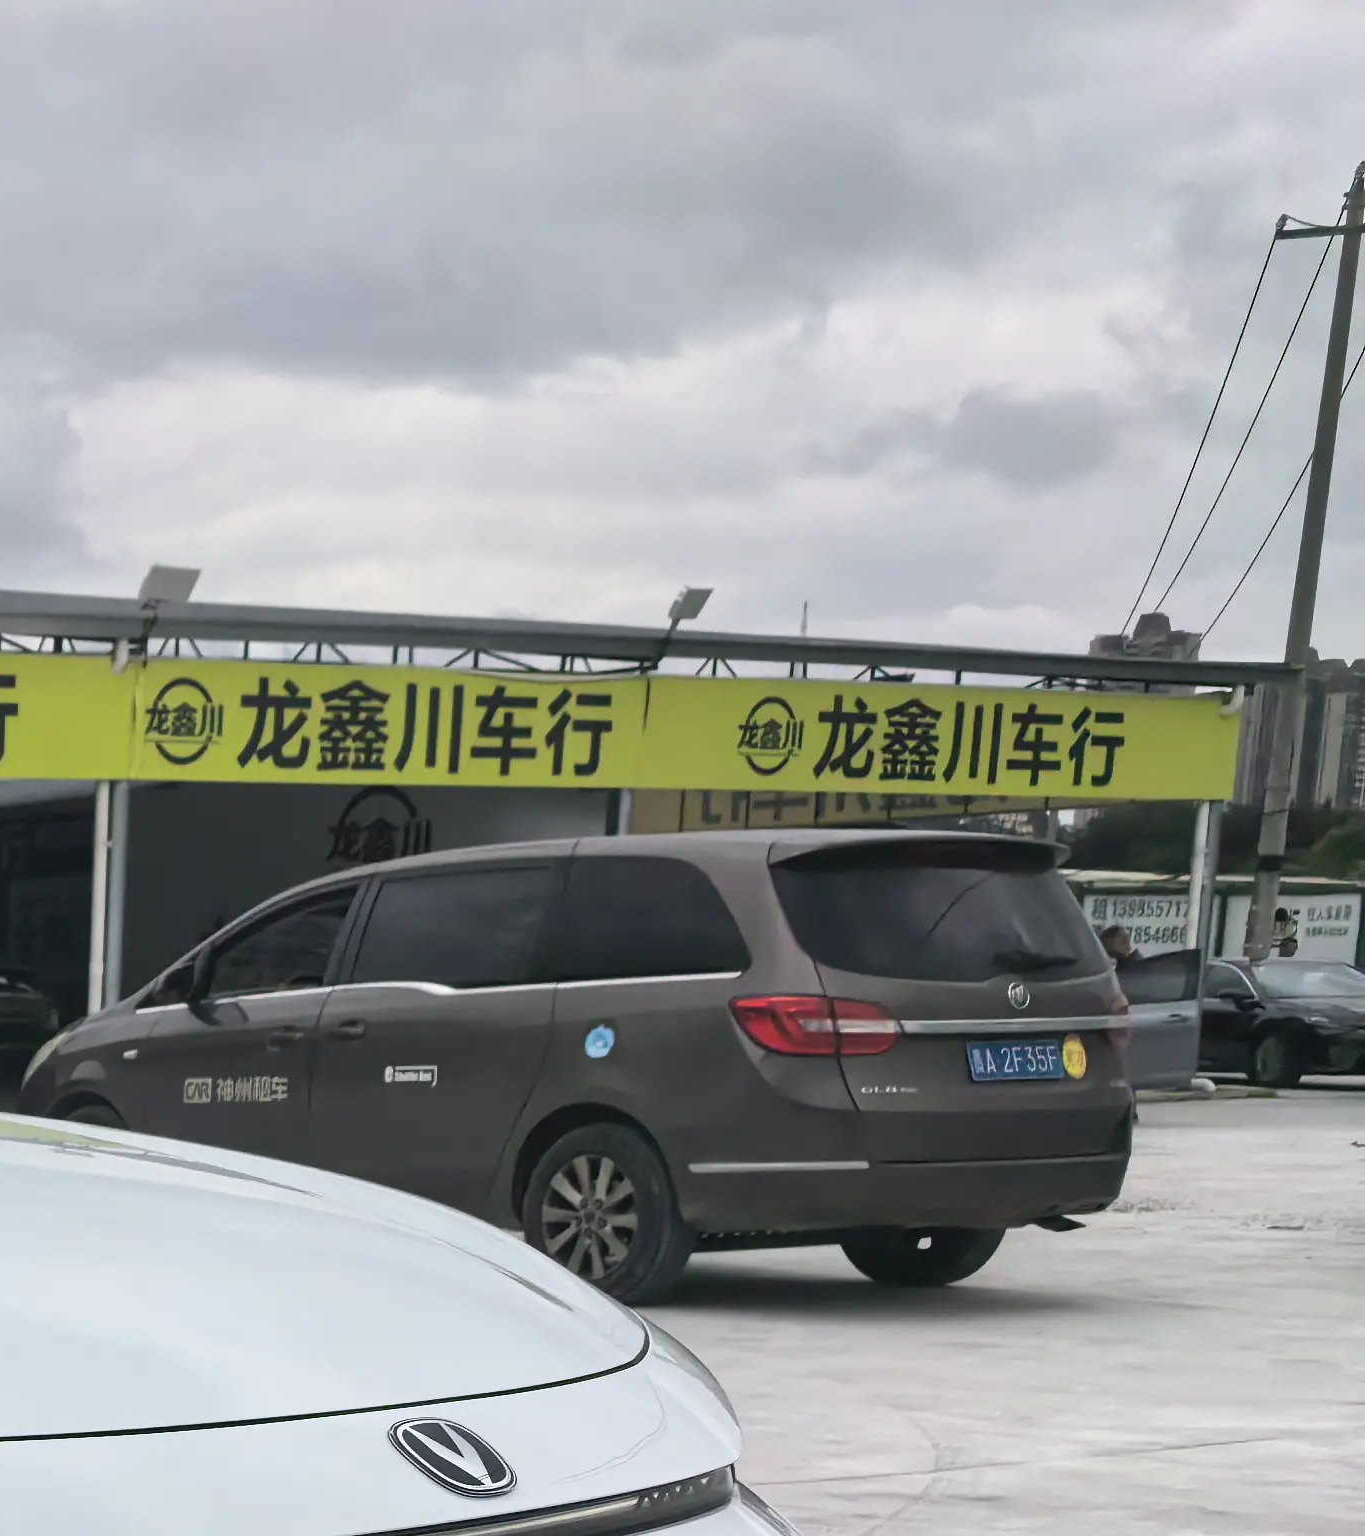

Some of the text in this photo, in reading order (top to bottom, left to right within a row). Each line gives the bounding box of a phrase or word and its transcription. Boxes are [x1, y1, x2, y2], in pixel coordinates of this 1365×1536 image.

[145, 702, 223, 737] 龙鑫川
[237, 676, 613, 777] 龙鑫川车行
[813, 695, 1125, 786] 龙鑫川车行
